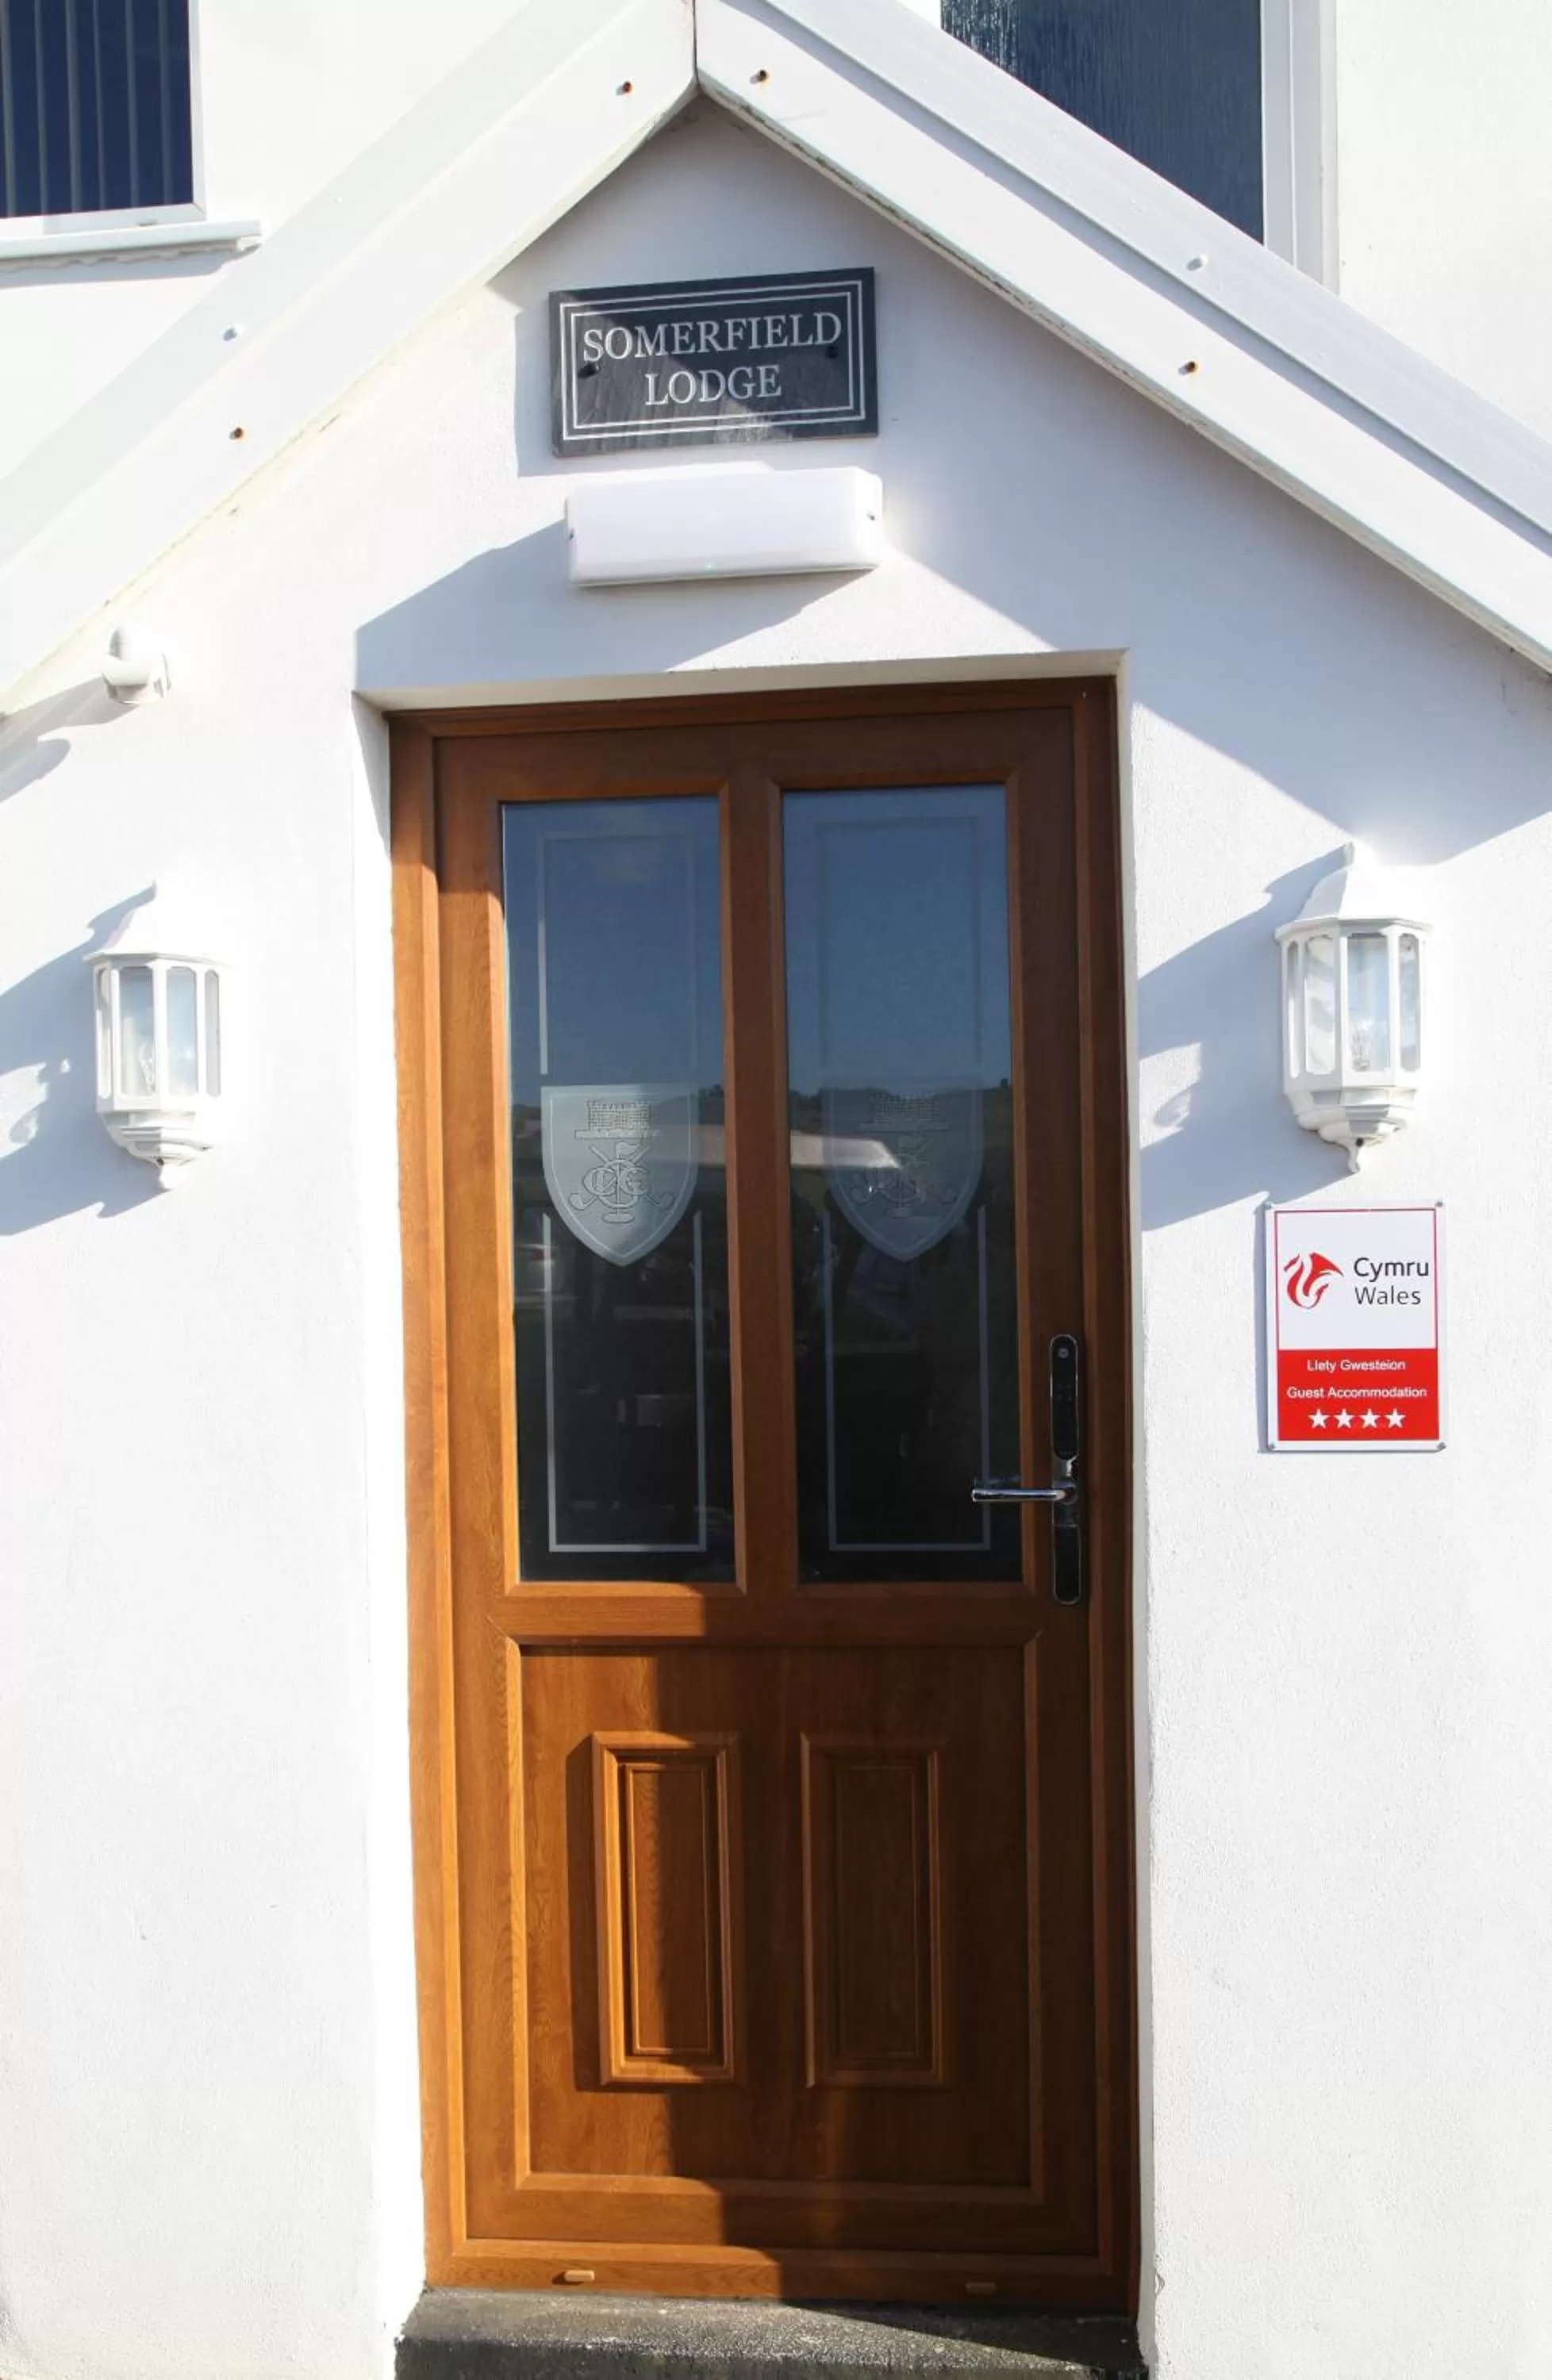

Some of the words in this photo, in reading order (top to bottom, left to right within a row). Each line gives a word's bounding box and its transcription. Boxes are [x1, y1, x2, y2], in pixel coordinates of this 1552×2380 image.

[583, 311, 843, 363] SOMERFIELD
[645, 364, 782, 405] LODGE
[1354, 1257, 1429, 1282] Cymru
[1354, 1286, 1422, 1305] Wales
[1340, 1359, 1406, 1371] Gwesteion
[1286, 1386, 1324, 1399] Guest
[1327, 1386, 1427, 1399] Accommodation
